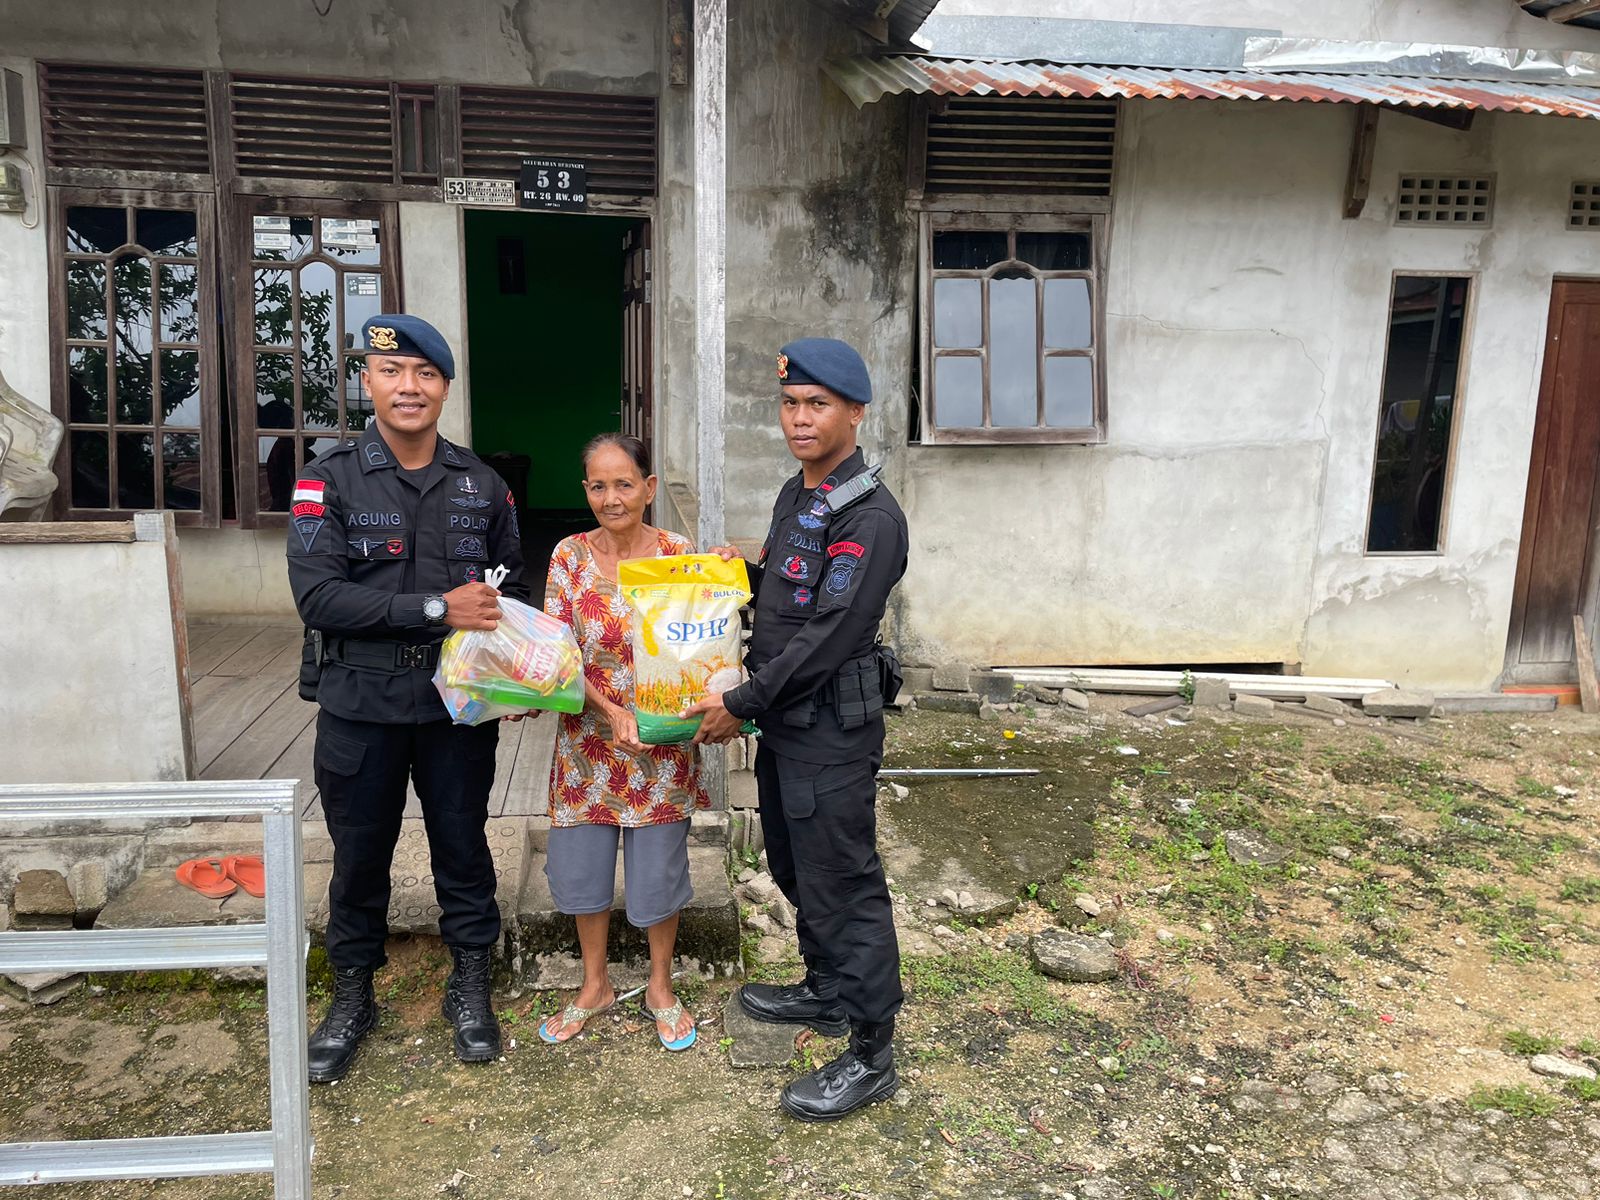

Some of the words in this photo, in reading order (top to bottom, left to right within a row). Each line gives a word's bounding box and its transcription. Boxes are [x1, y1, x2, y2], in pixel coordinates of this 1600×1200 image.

[448, 182, 465, 195] 53
[523, 190, 537, 200] RT.
[539, 192, 551, 200] 26
[555, 193, 571, 201] RW.
[572, 194, 584, 203] 09
[348, 512, 401, 526] AGUNG
[450, 514, 489, 530] POLRI
[787, 531, 821, 552] POLRI
[666, 618, 728, 642] SPHP
